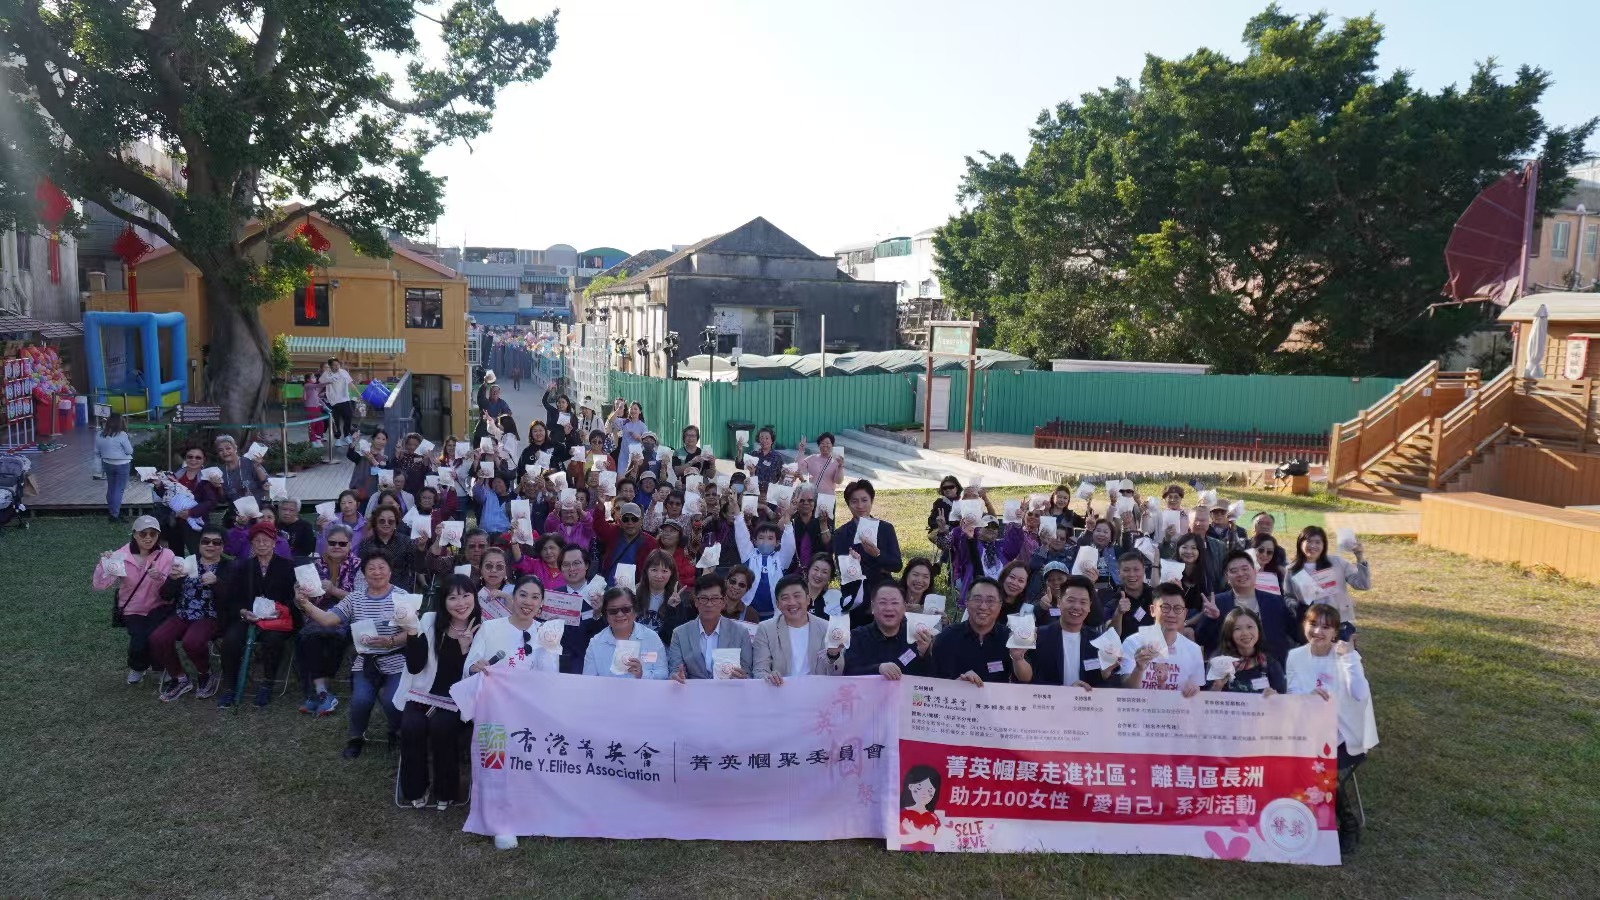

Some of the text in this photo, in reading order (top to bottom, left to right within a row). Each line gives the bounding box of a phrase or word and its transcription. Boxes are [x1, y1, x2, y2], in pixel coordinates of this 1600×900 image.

[1169, 673, 1179, 683] IT
[510, 727, 661, 768] 香港菁英會
[689, 743, 886, 771] 菁英幗聚委員會
[509, 756, 660, 782] The Y.Elites Association
[954, 820, 984, 837] SELF
